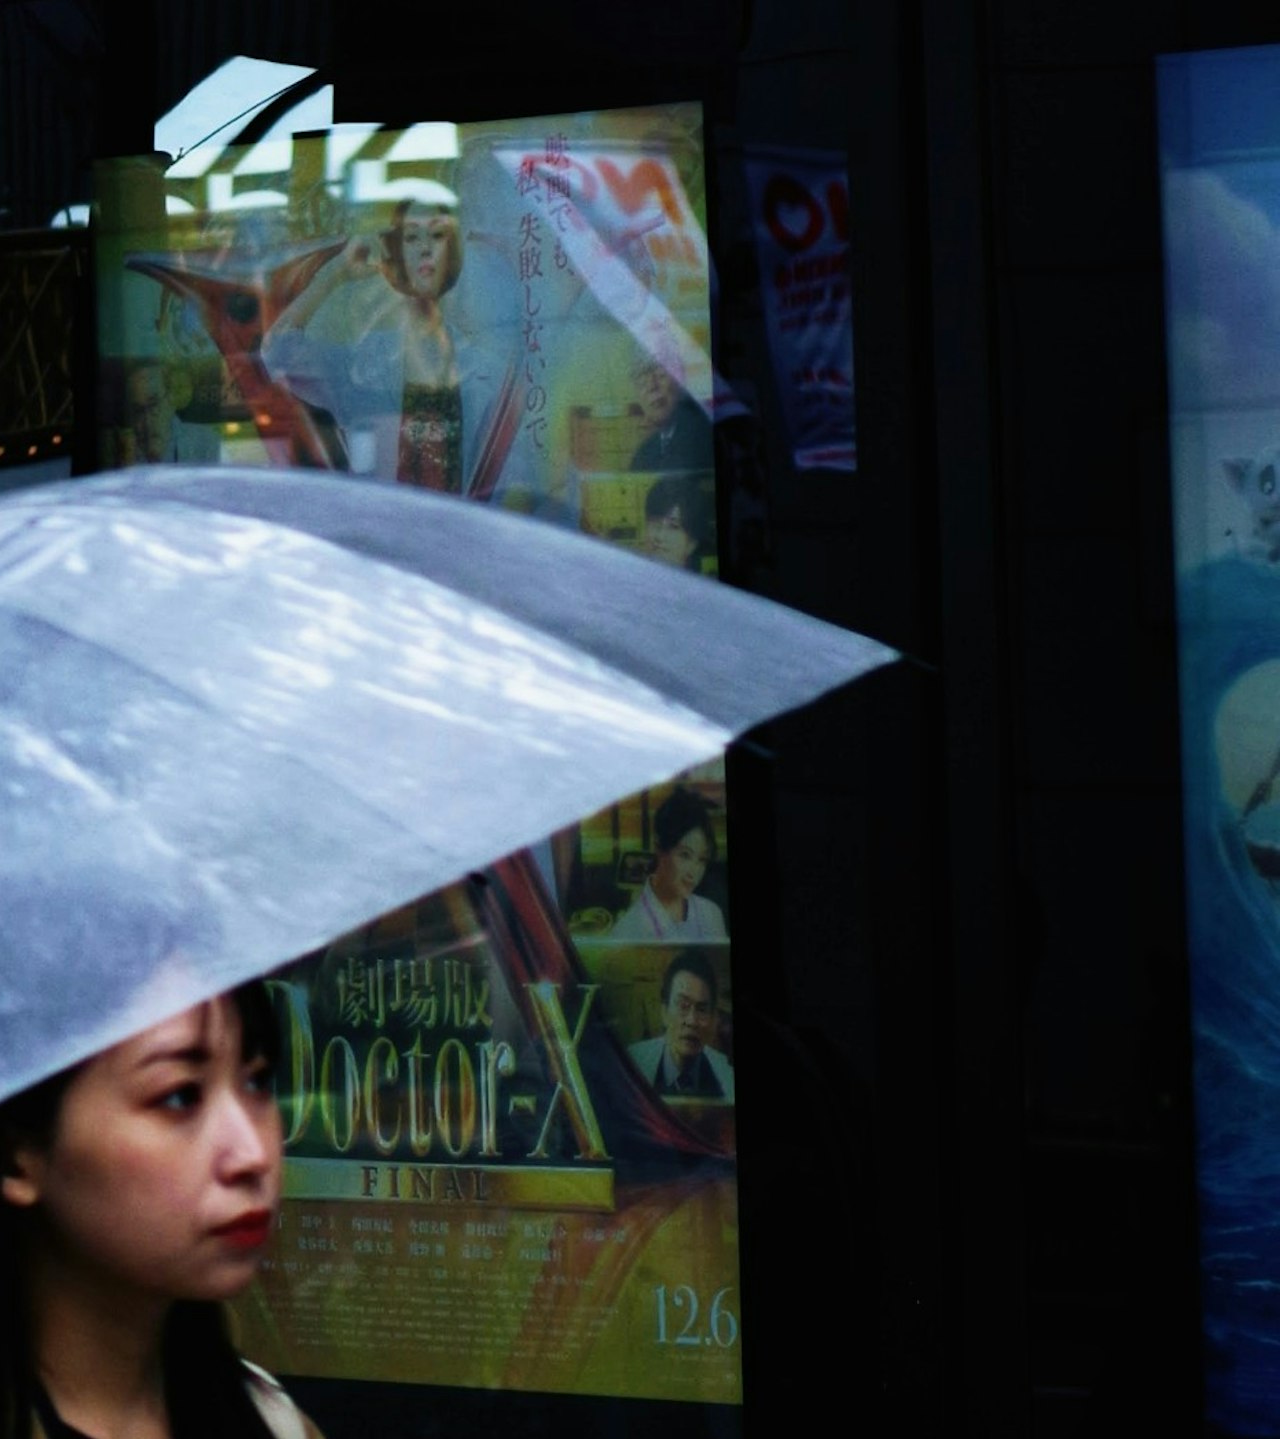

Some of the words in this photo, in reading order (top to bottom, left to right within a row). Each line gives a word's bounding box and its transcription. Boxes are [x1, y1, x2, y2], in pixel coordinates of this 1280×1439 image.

[338, 958, 492, 1027] 劇場版
[362, 1164, 488, 1202] FINAL
[652, 1284, 737, 1346] 12.6
